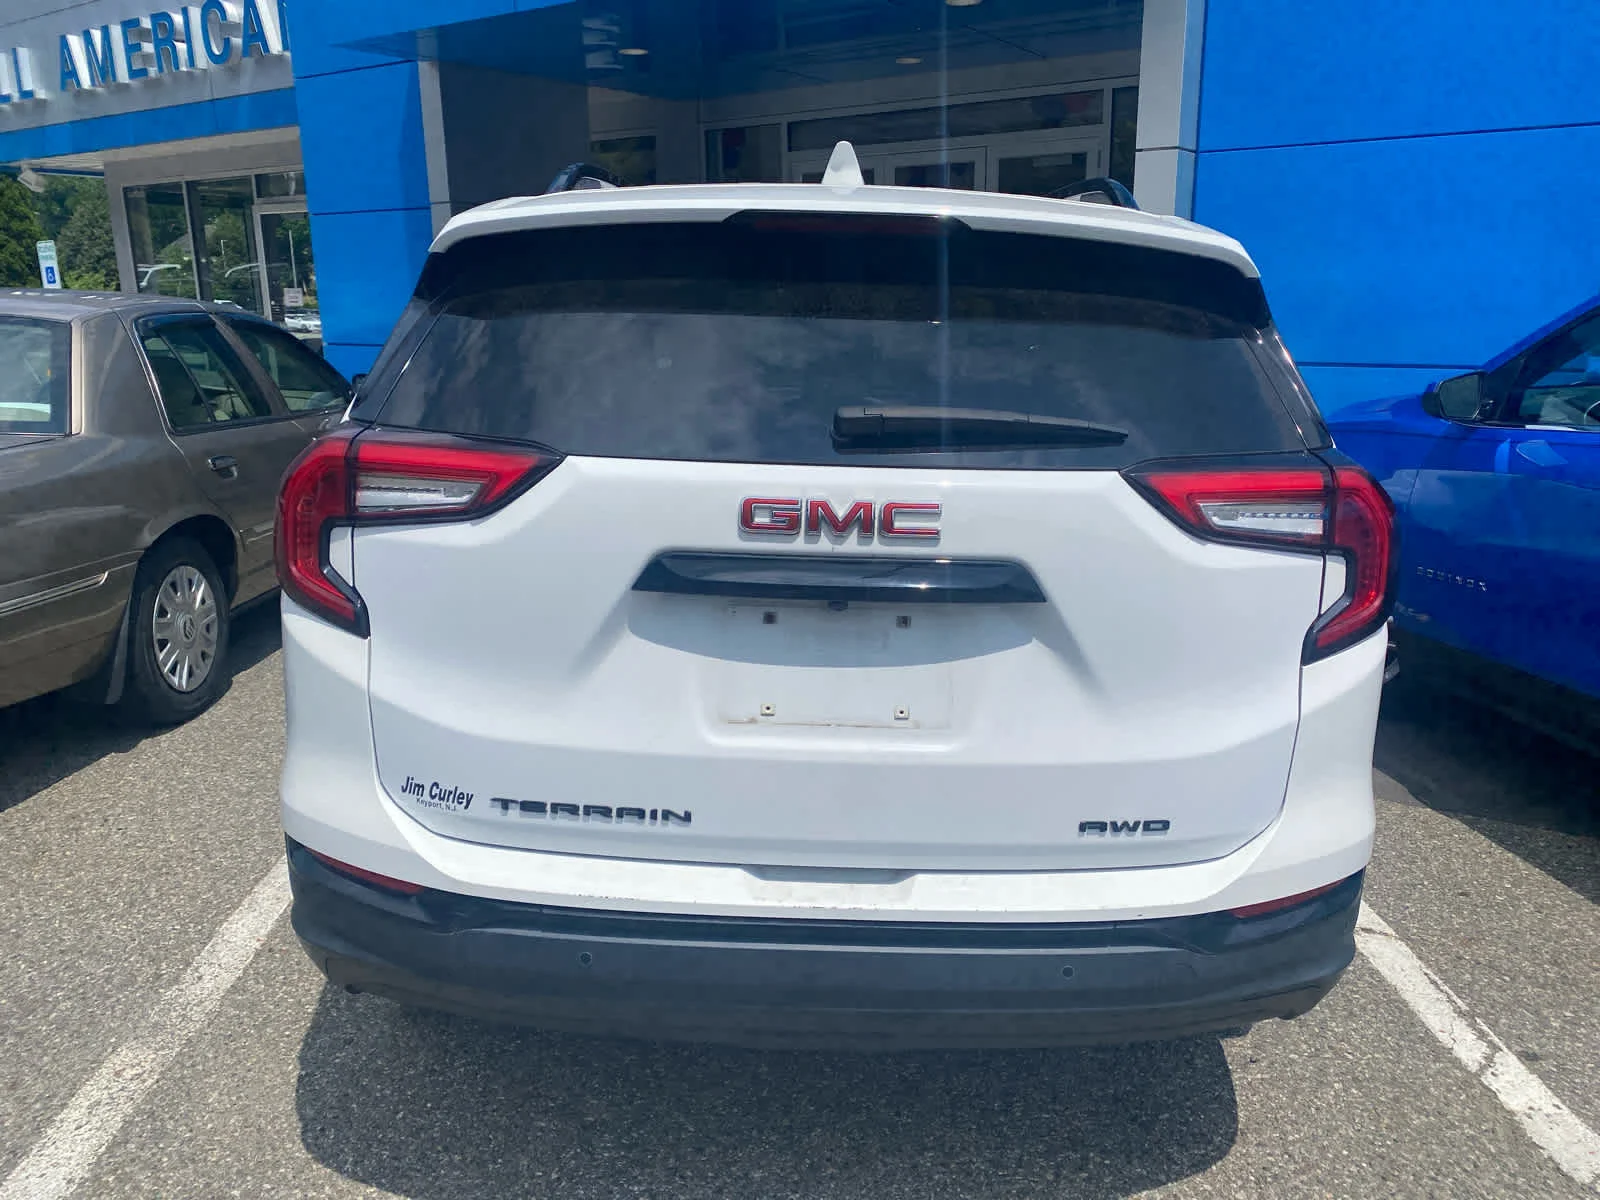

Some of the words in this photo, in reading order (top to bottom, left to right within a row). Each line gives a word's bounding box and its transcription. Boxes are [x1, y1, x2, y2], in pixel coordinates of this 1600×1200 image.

[739, 497, 941, 538] GMC
[401, 776, 425, 797] Jim
[429, 781, 474, 810] Curley
[490, 797, 692, 823] TERRAIN
[1078, 819, 1171, 833] AWD
